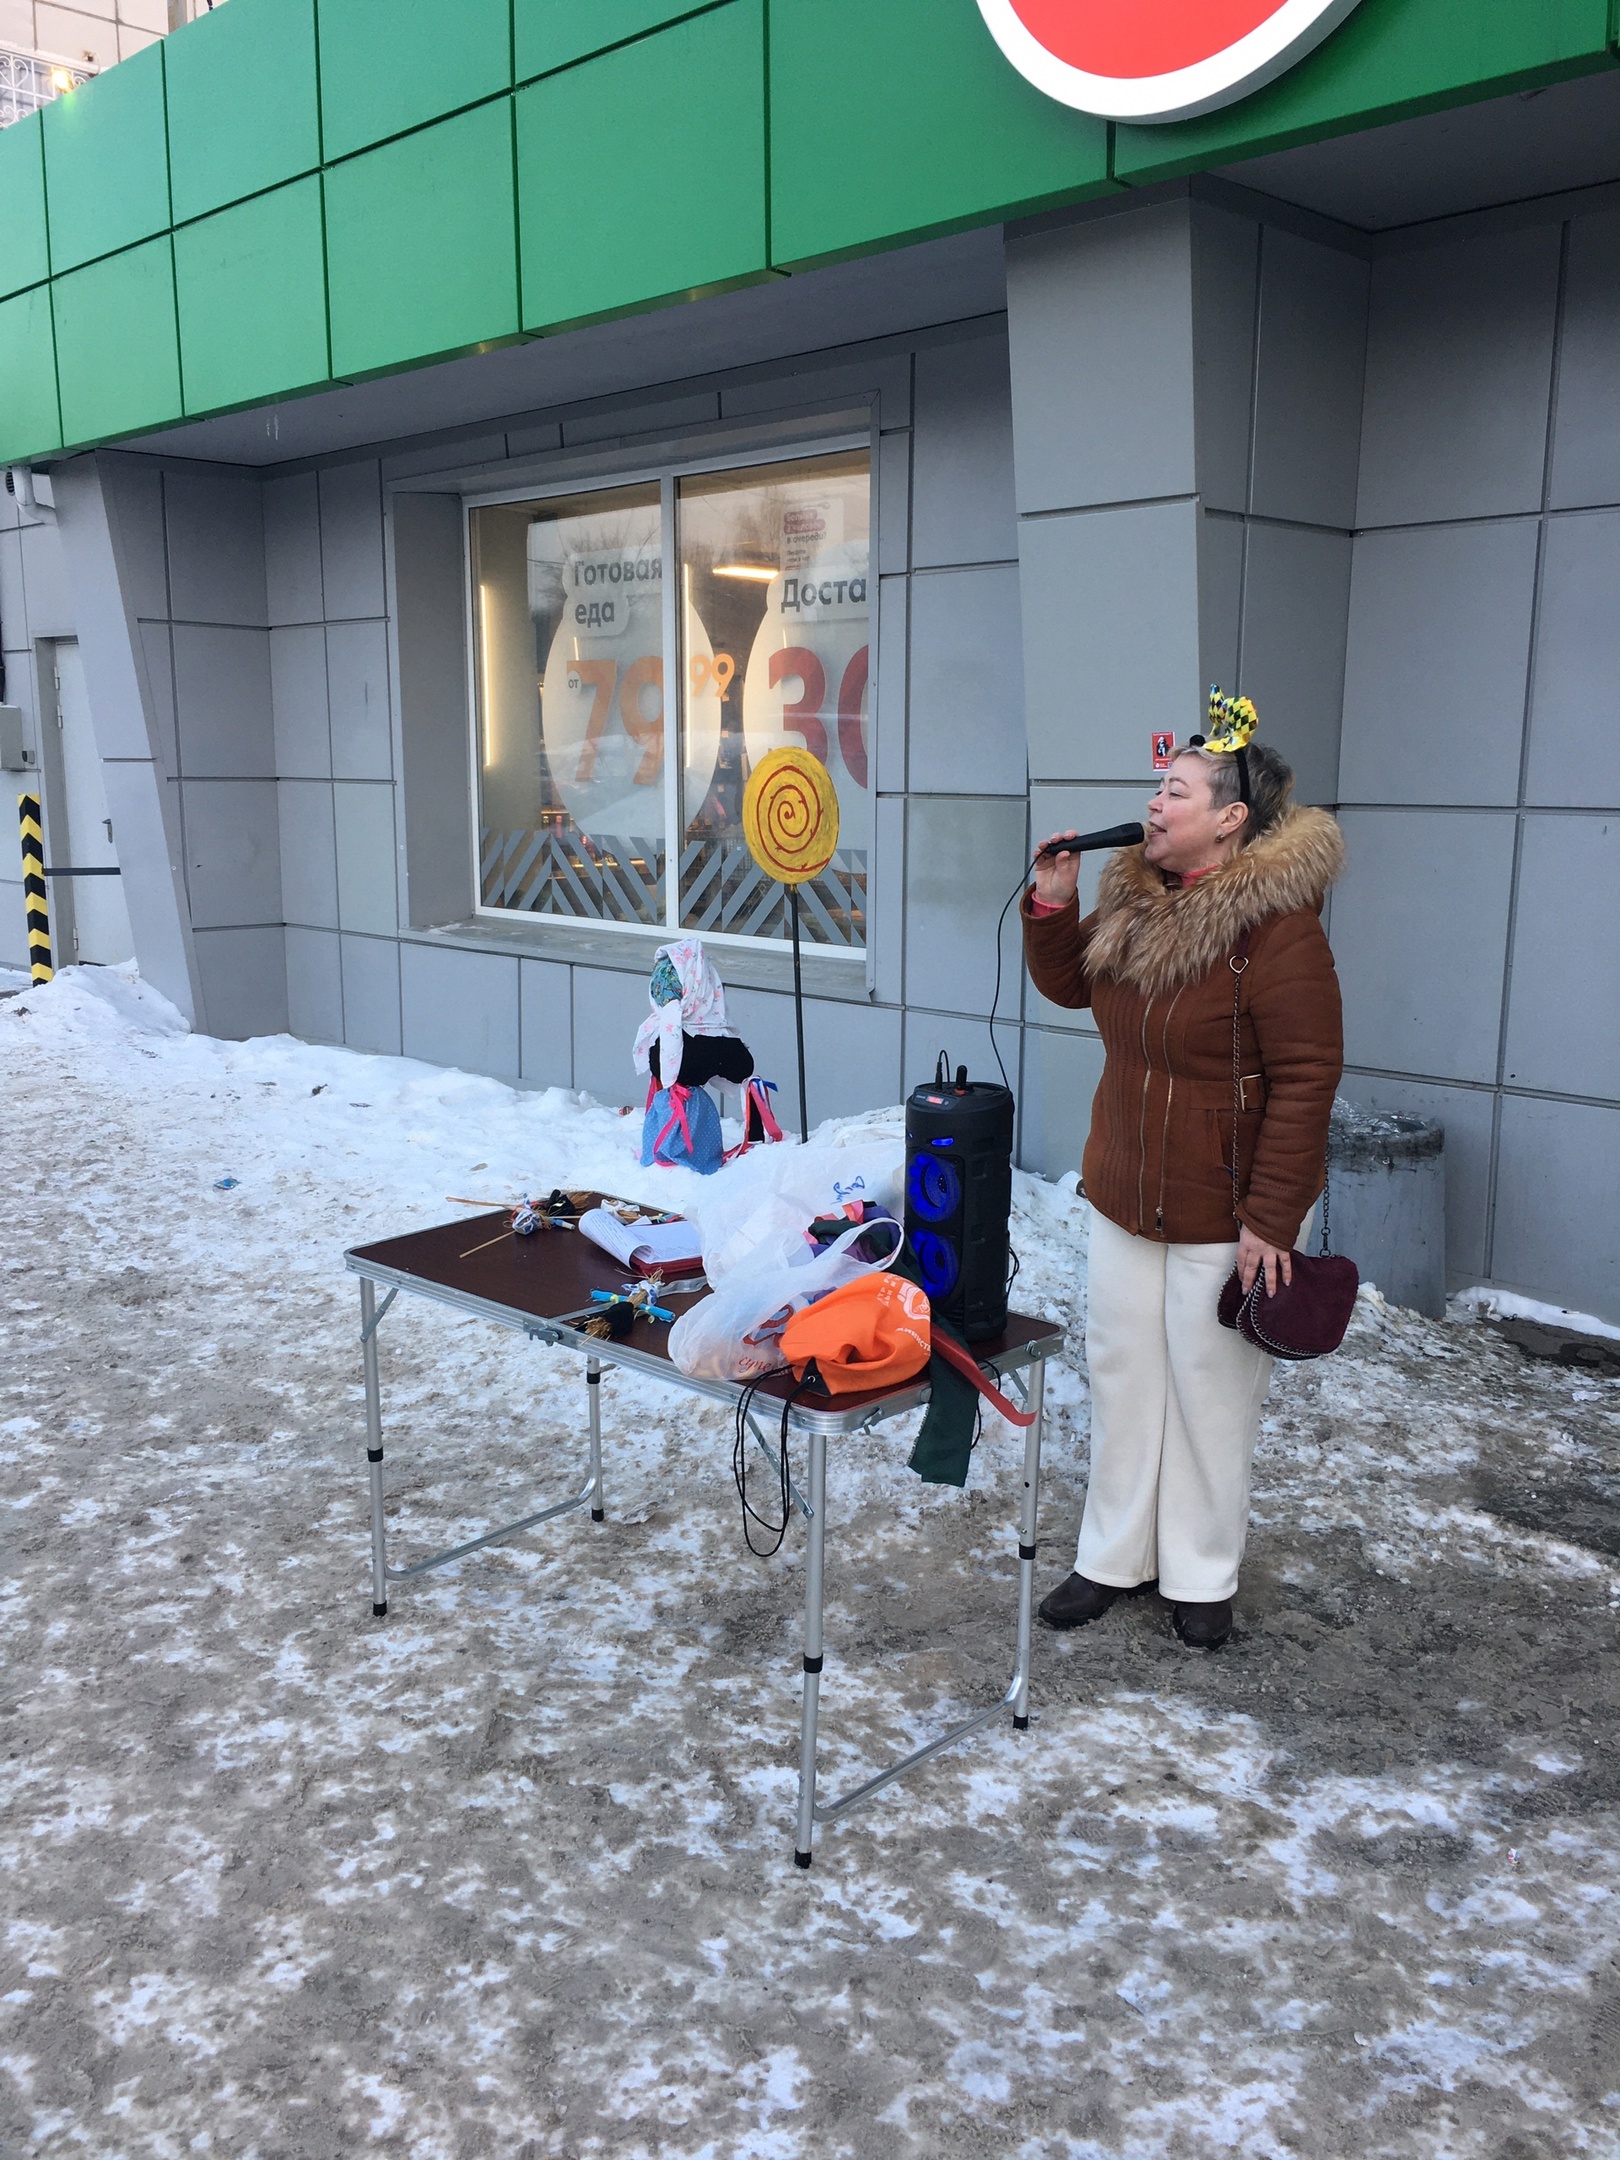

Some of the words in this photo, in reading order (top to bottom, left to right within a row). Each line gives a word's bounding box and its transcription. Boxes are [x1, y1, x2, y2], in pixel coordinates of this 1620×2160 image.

[575, 558, 662, 586] Готовая
[781, 579, 867, 613] Доста
[575, 602, 615, 628] еда
[568, 679, 579, 689] от
[690, 653, 734, 697] 99
[566, 655, 663, 784] 79
[739, 1356, 774, 1374] супе
